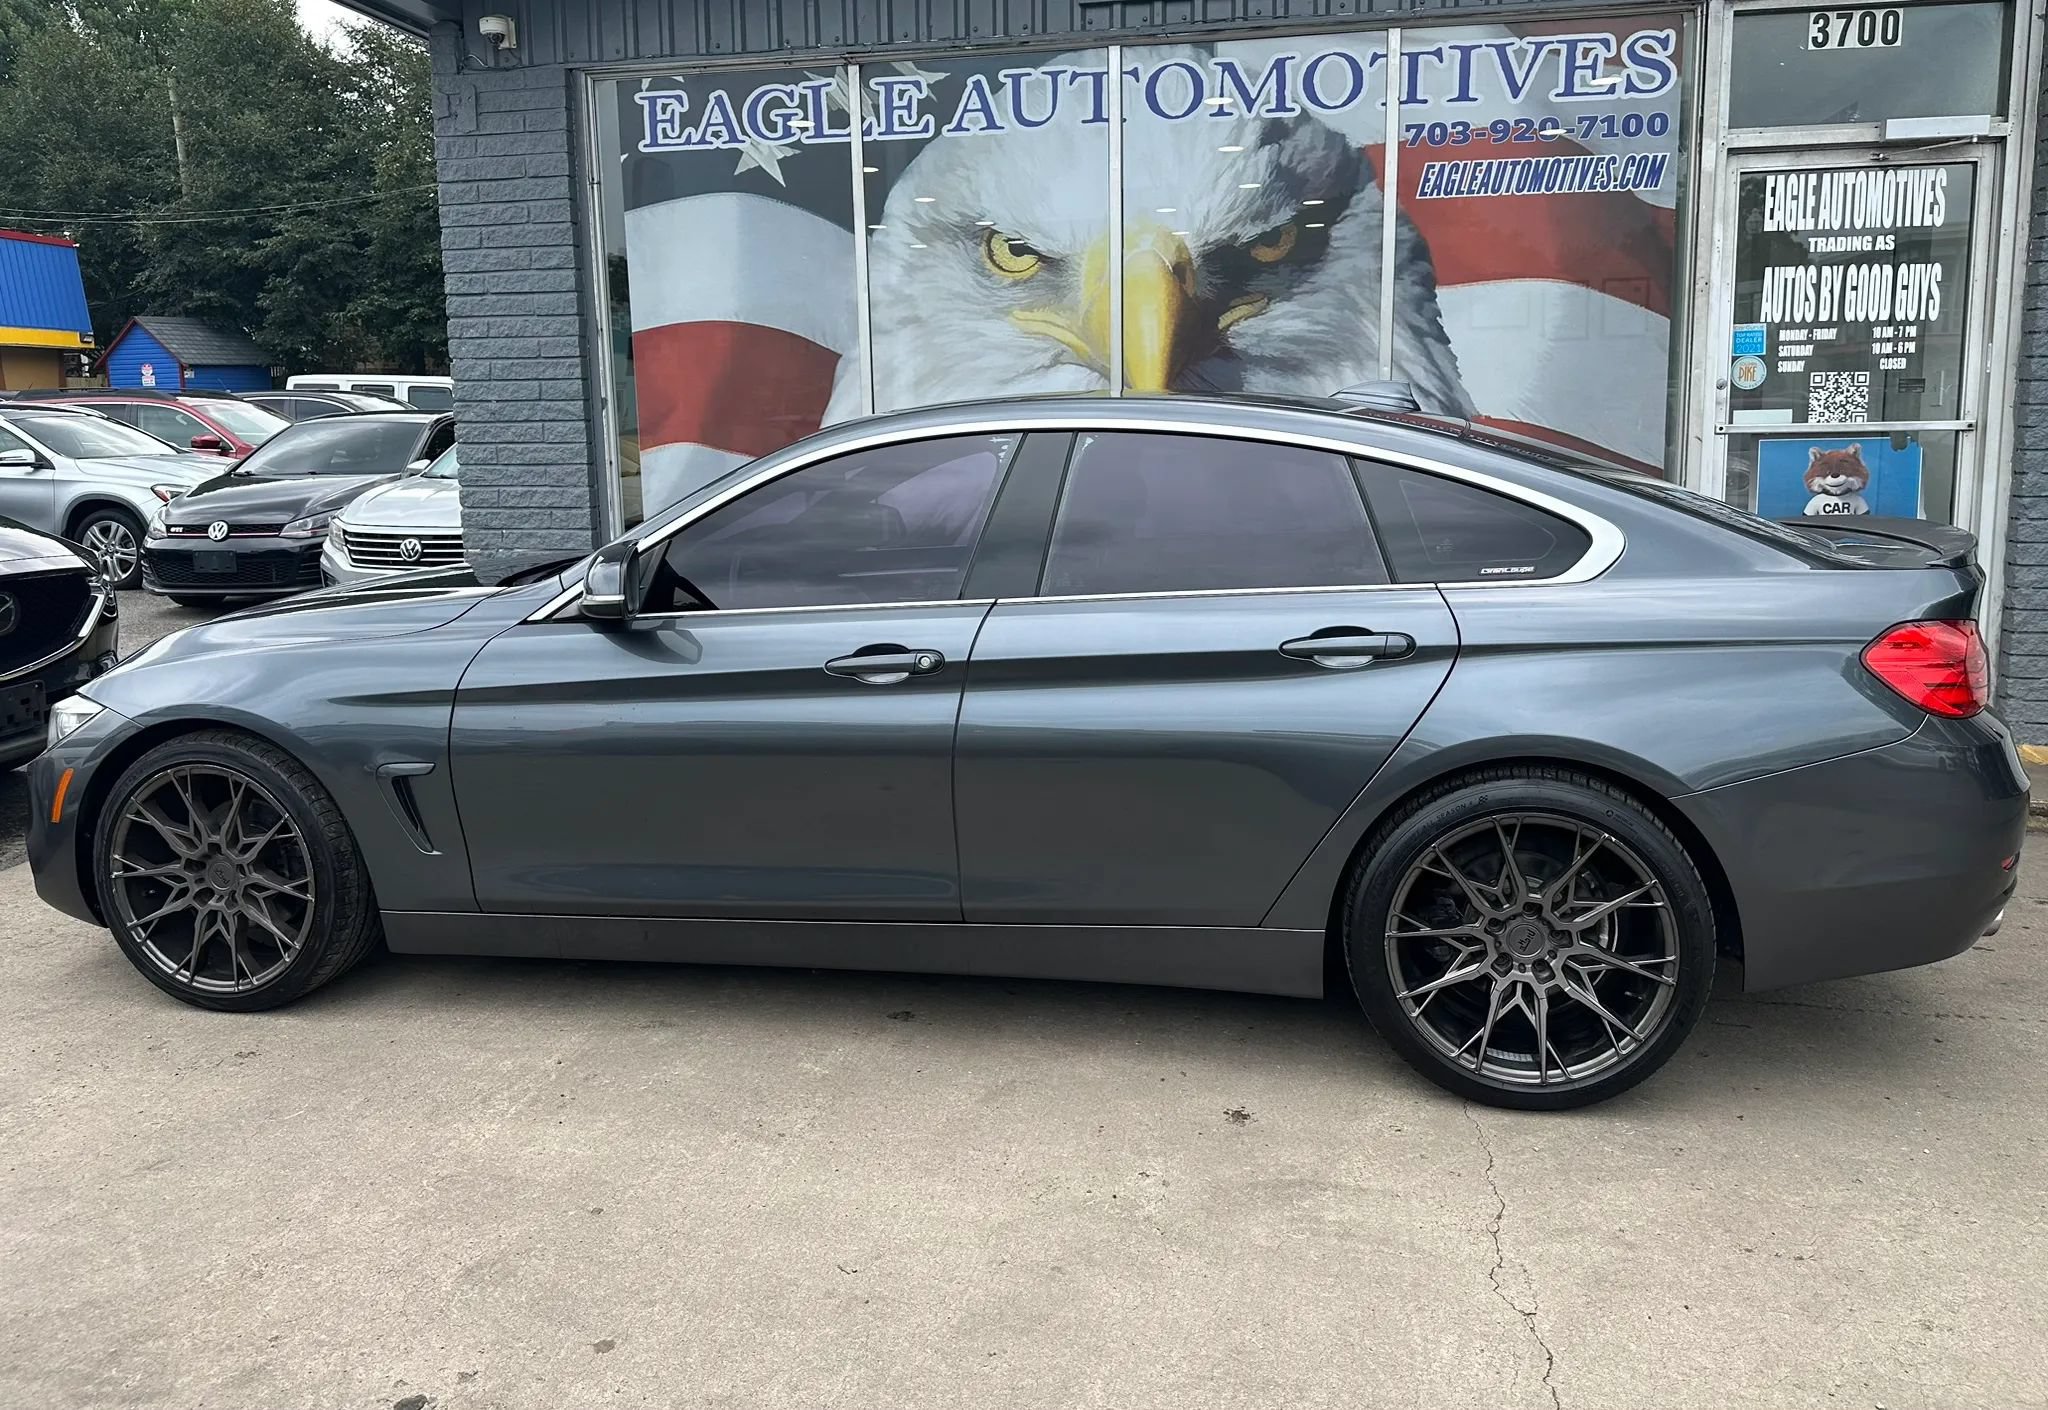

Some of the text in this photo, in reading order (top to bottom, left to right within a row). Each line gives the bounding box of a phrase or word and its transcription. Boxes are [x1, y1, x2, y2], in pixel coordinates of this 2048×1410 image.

[1811, 10, 1900, 48] 3700
[636, 29, 1678, 151] EAGLE AUTOMOTIVES
[1405, 111, 1669, 147] 703-920-7100
[1416, 153, 1670, 199] EAGLEAUTOMOTIVES.COM
[1763, 168, 1947, 232] EAGLE AUTOMOTIVES
[1808, 235, 1895, 252] TRADING AS
[1760, 262, 1942, 323] AUTOS BY GOOD GUYS
[1779, 329, 1808, 341] MONDAY
[1813, 328, 1838, 340] FRIDAY
[1882, 326, 1893, 338] AM
[1905, 325, 1917, 337] PM
[1778, 345, 1814, 357] SATURDAY
[1881, 342, 1893, 354] AM
[1898, 341, 1903, 353] 6
[1904, 341, 1916, 353] PM
[1777, 360, 1805, 373] SUNDAY
[1880, 357, 1907, 370] CLOSED
[1823, 501, 1851, 514] CAR
